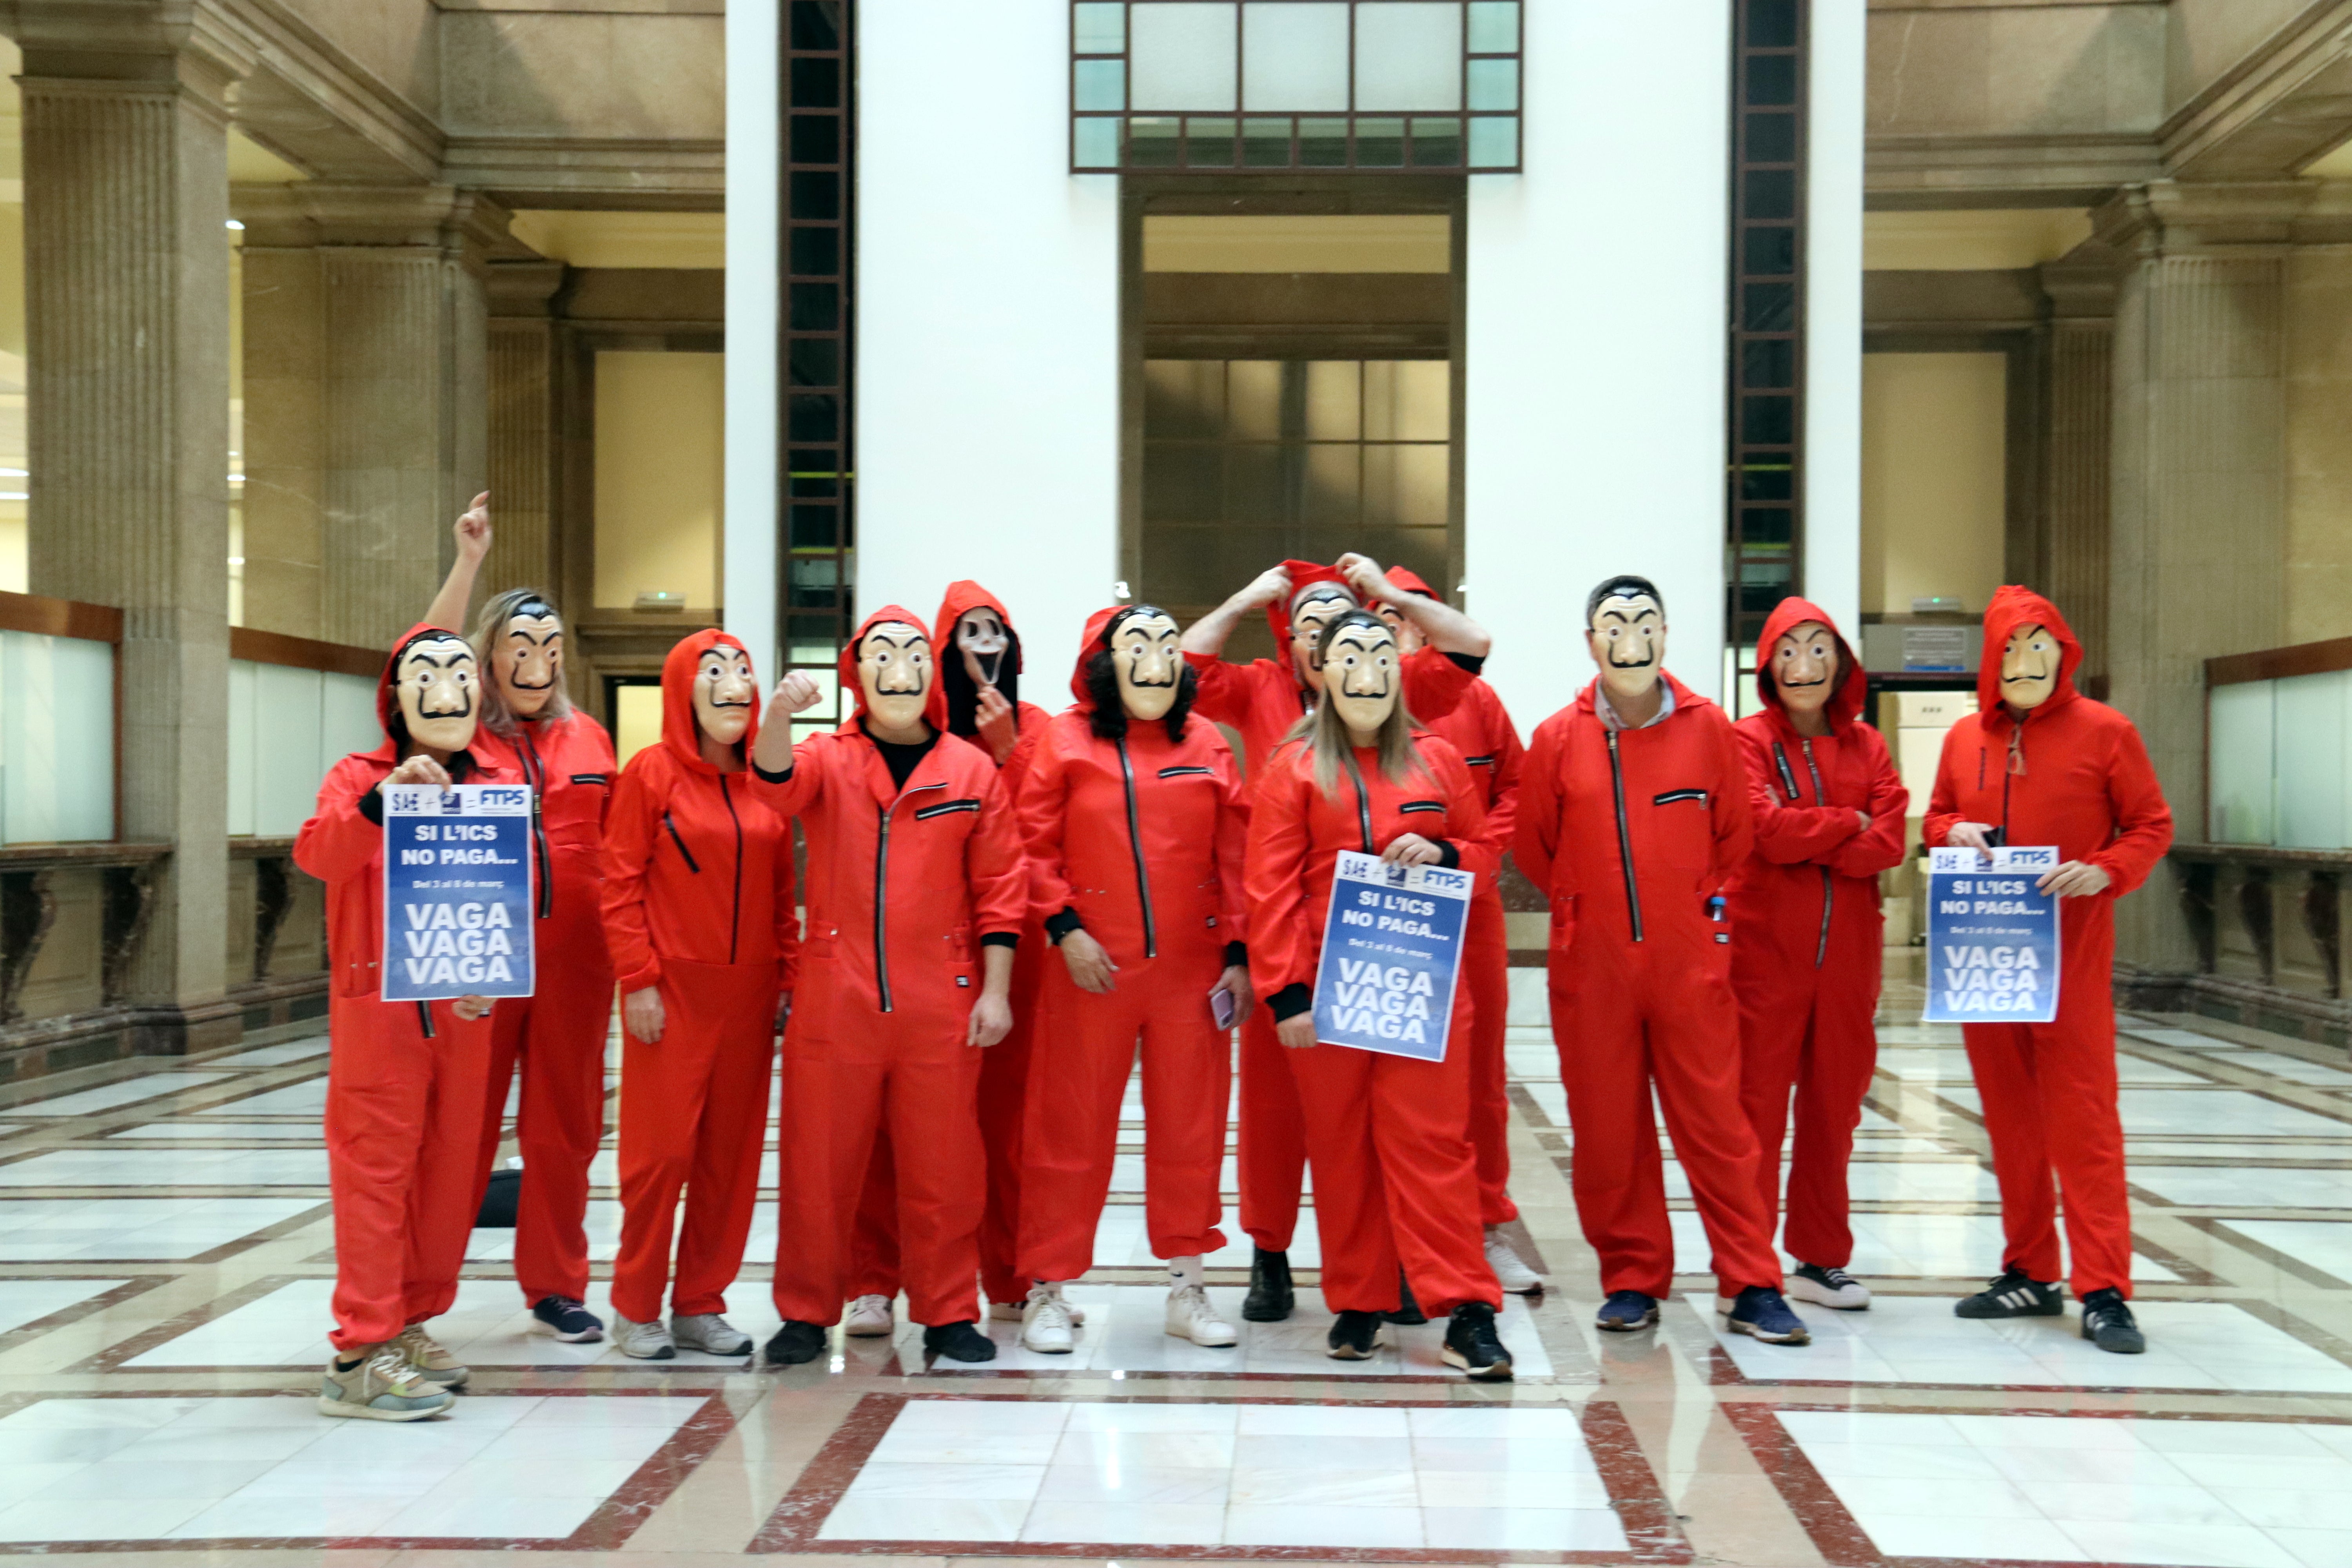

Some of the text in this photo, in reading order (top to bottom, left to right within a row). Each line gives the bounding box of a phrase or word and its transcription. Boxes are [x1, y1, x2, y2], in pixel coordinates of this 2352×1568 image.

[481, 789, 524, 805] FTPS
[415, 825, 498, 841] SI L'ICS
[401, 849, 436, 865] NO
[2011, 851, 2051, 864] FTPS
[1424, 870, 1466, 889] FTPS
[1952, 880, 2027, 895] SI L'ICS
[1358, 891, 1436, 916] SI L'ICS
[1940, 901, 1969, 914] NO
[404, 902, 512, 930] VAGA
[1342, 909, 1374, 927] NO
[404, 929, 512, 957] VAGA
[1348, 938, 1367, 947] Del
[1943, 946, 2040, 969] VAGA
[404, 956, 513, 984] VAGA
[1338, 957, 1434, 996] VAGA
[1943, 968, 2038, 991] VAGA
[1334, 981, 1430, 1020] VAGA
[1943, 991, 2036, 1011] VAGA
[1330, 1005, 1426, 1044] VAGA
